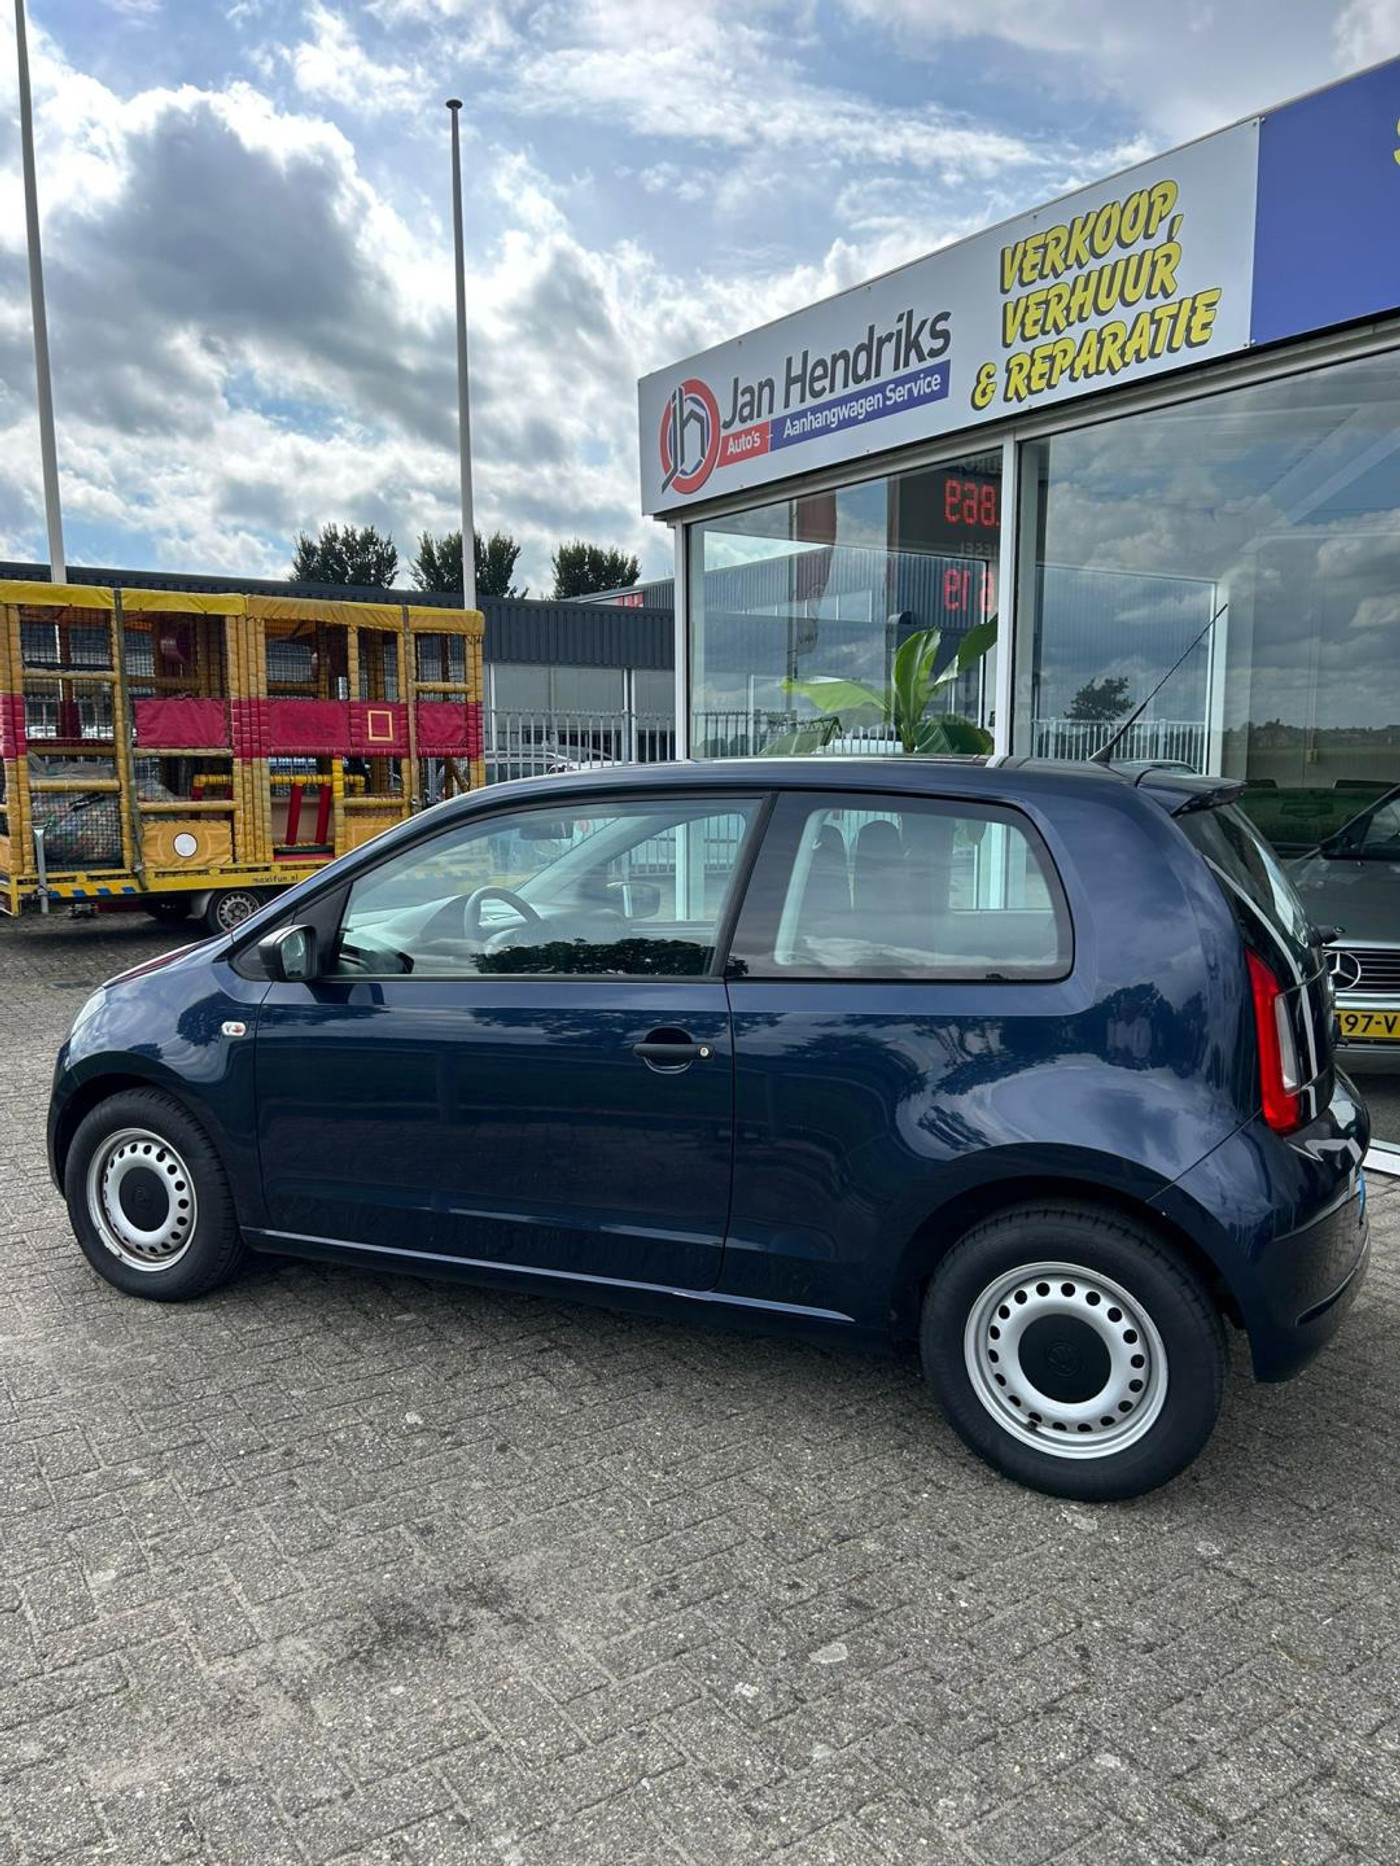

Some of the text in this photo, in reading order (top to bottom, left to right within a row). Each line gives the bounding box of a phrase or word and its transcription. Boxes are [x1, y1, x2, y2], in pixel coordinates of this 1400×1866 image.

[1001, 180, 1184, 293] VERKOOP,
[971, 287, 1222, 410] & REPARATIE
[1003, 241, 1182, 348] VERHUUR
[722, 308, 952, 430] Jan Hendriks
[727, 372, 941, 456] Auto's Aanhangwagen Service
